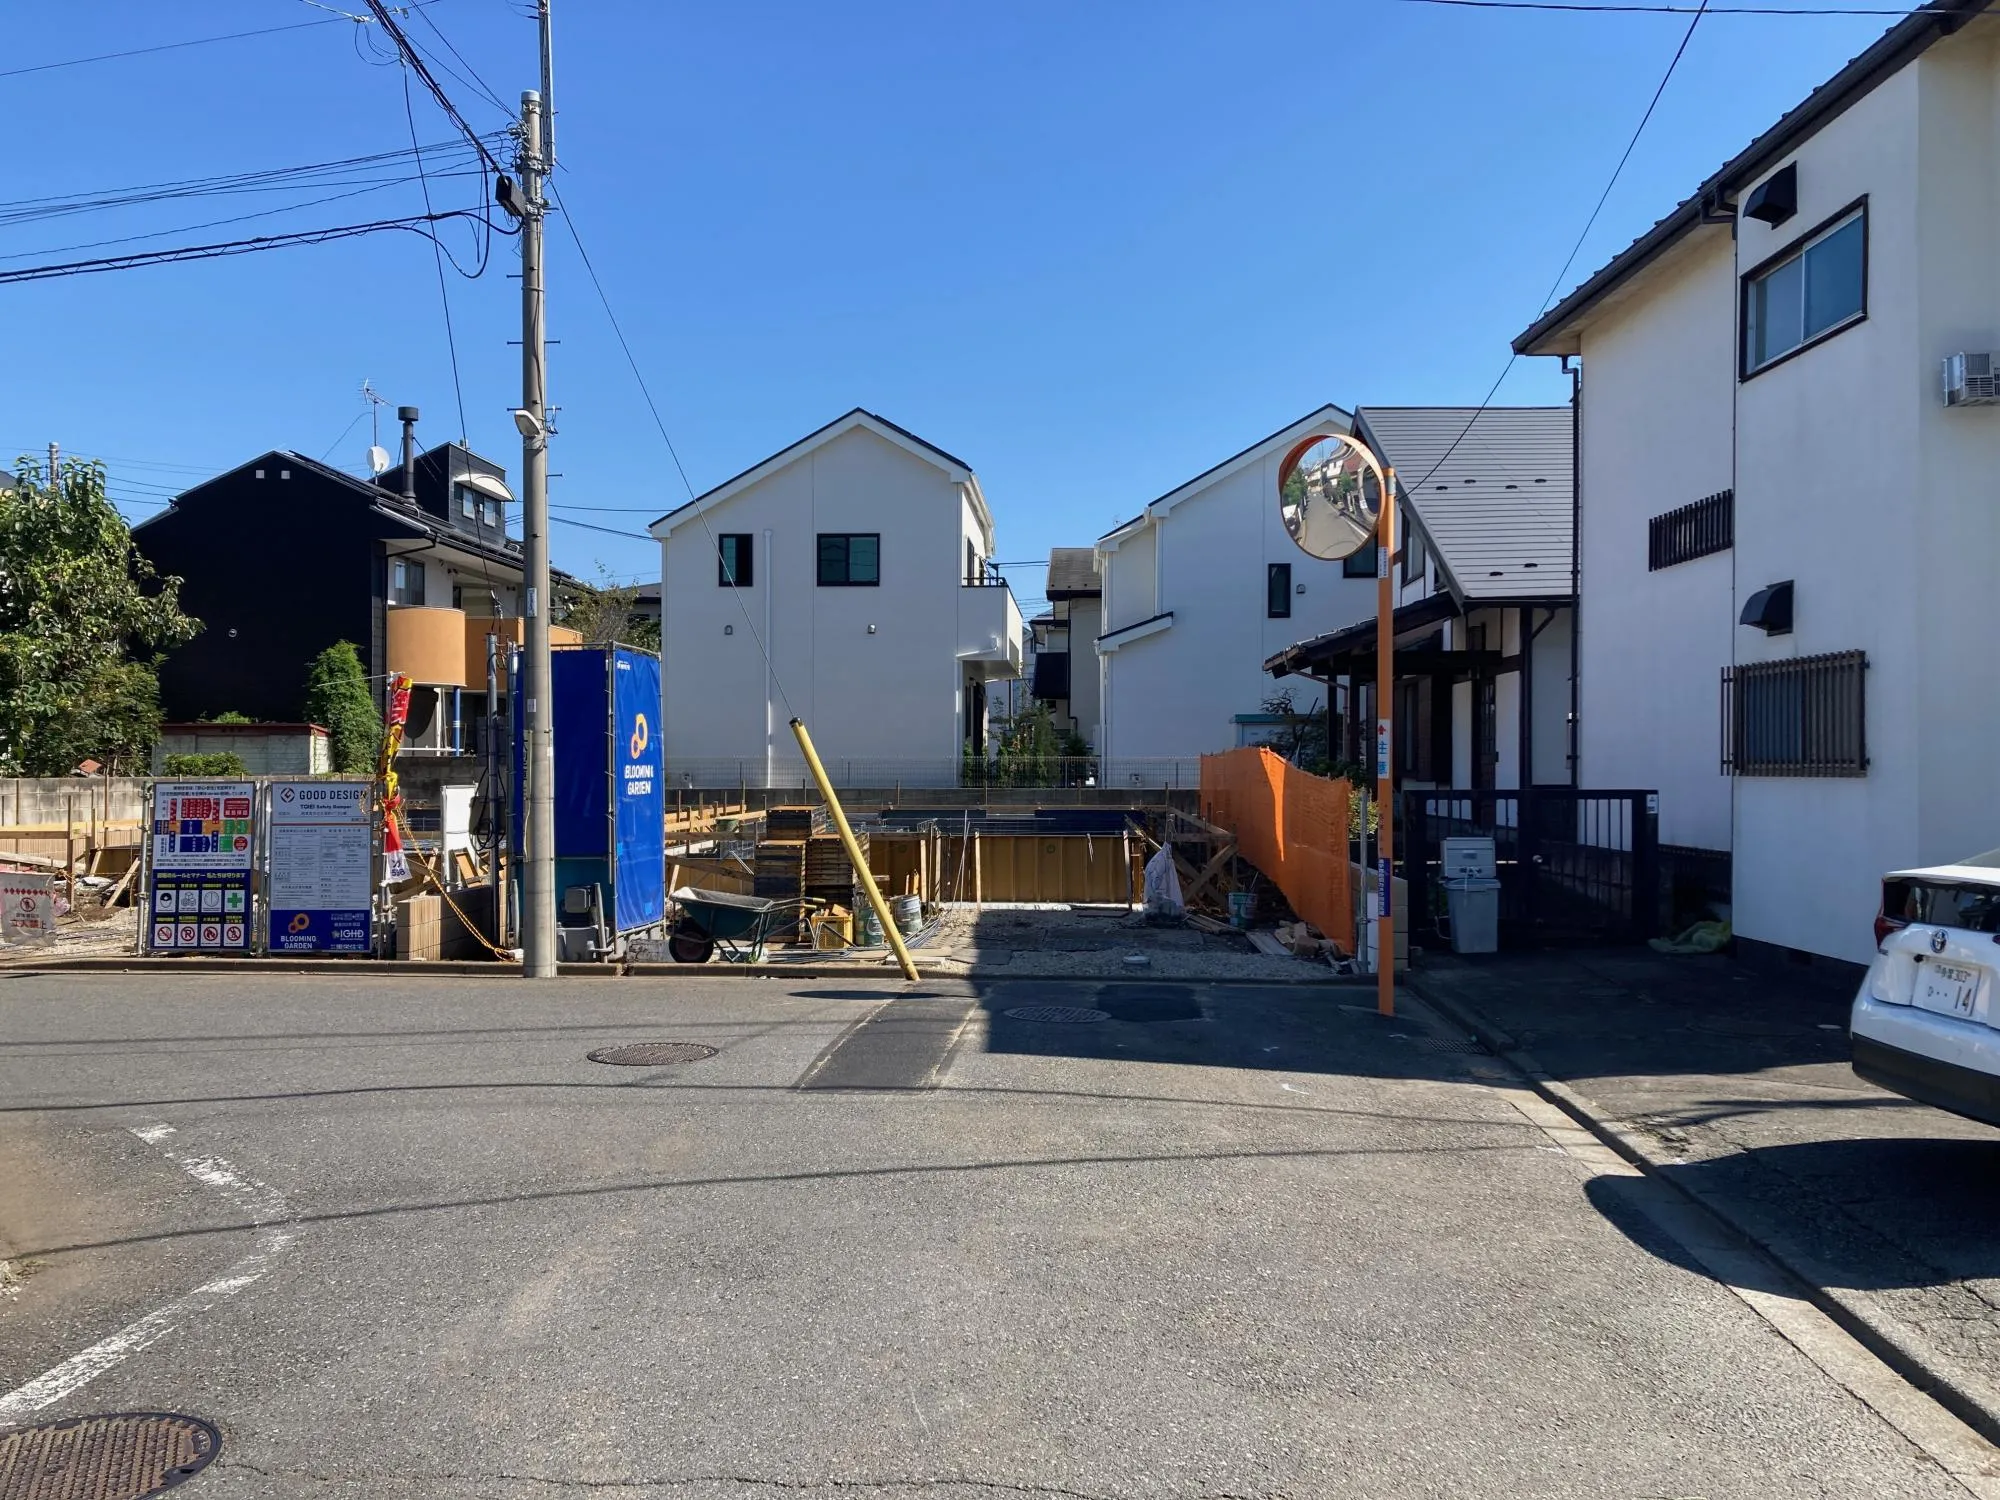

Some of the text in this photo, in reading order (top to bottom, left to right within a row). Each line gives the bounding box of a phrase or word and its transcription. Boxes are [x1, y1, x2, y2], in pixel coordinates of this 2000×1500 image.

[299, 790, 367, 800] GOOD DESIGN
[280, 935, 317, 943] BLOOMING
